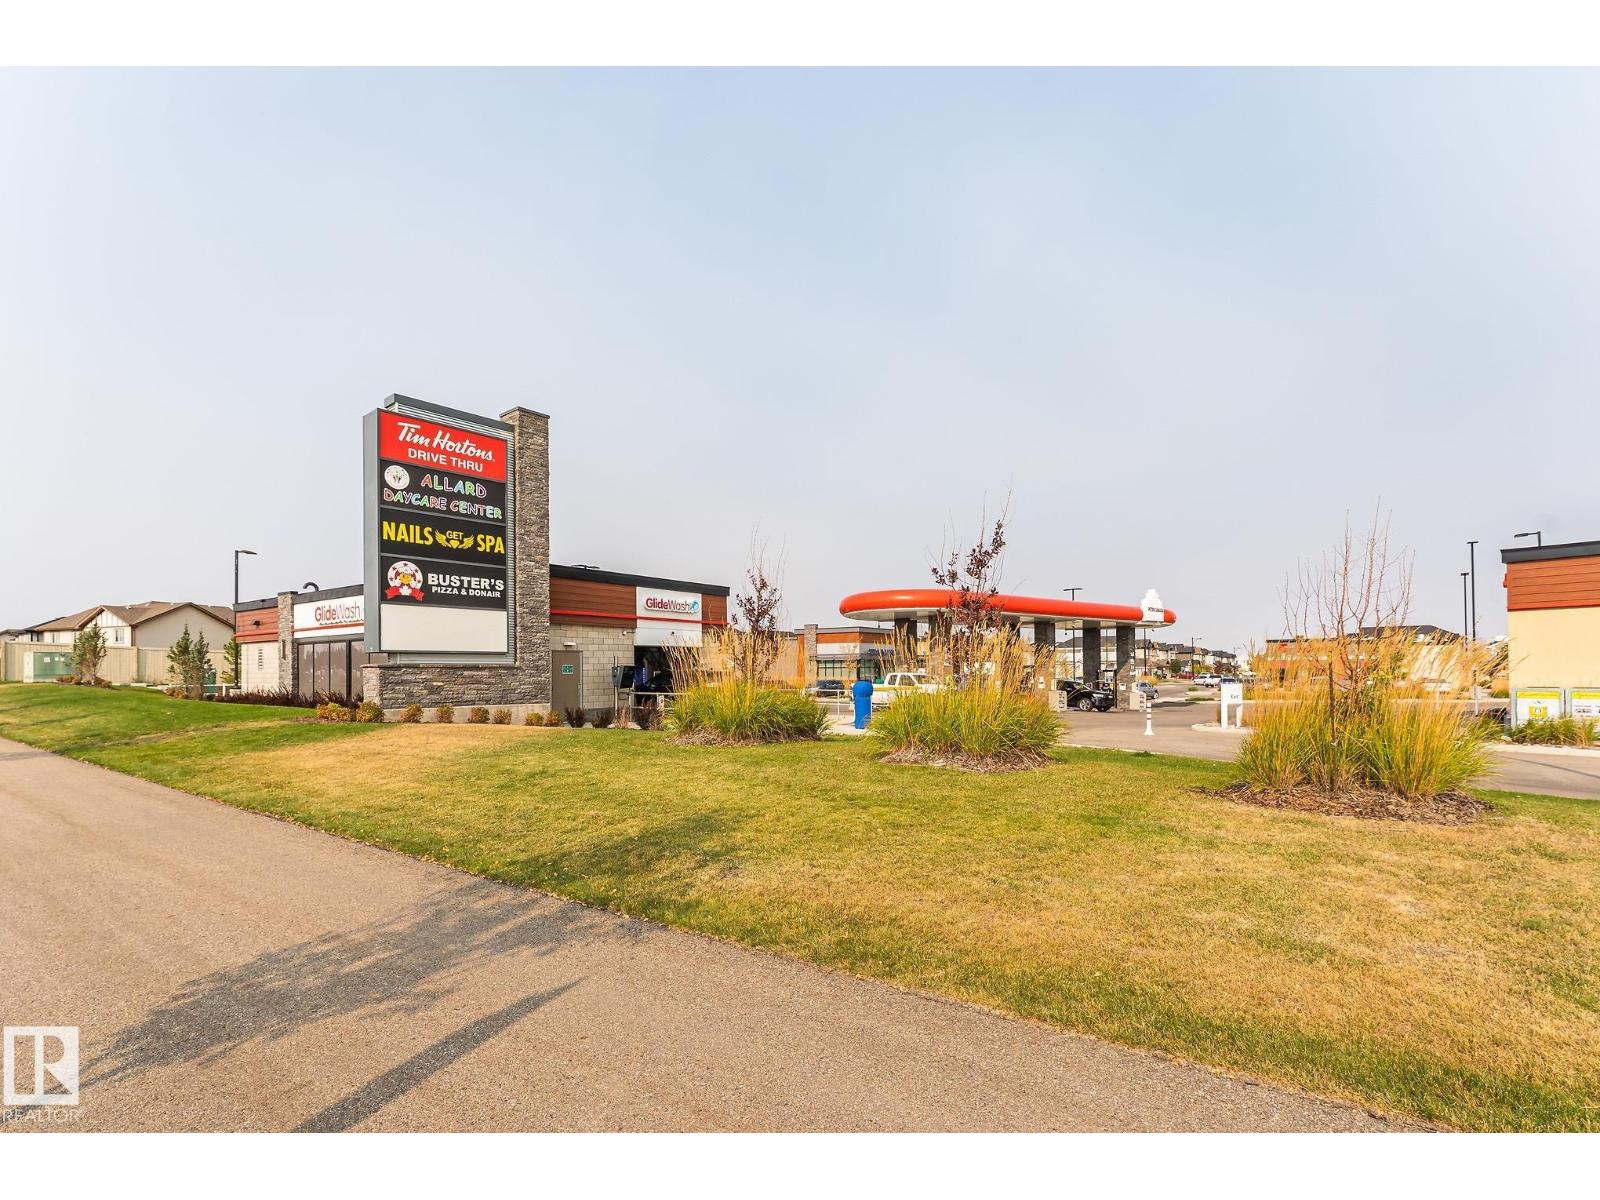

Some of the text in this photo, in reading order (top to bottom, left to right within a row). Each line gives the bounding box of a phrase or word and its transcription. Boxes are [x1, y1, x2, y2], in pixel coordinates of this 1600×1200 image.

[397, 421, 494, 462] Tim Hortons
[408, 448, 484, 472] DRIVE THRU
[421, 474, 487, 498] ALLARD
[383, 488, 503, 520] DAYCARE CENTER
[382, 521, 505, 554] NAILS GET SPA
[427, 573, 505, 591] BUSTER'S
[432, 586, 501, 598] PIZZA & DONAIR
[314, 601, 361, 622] GlideWash
[645, 597, 690, 611] GlideWash
